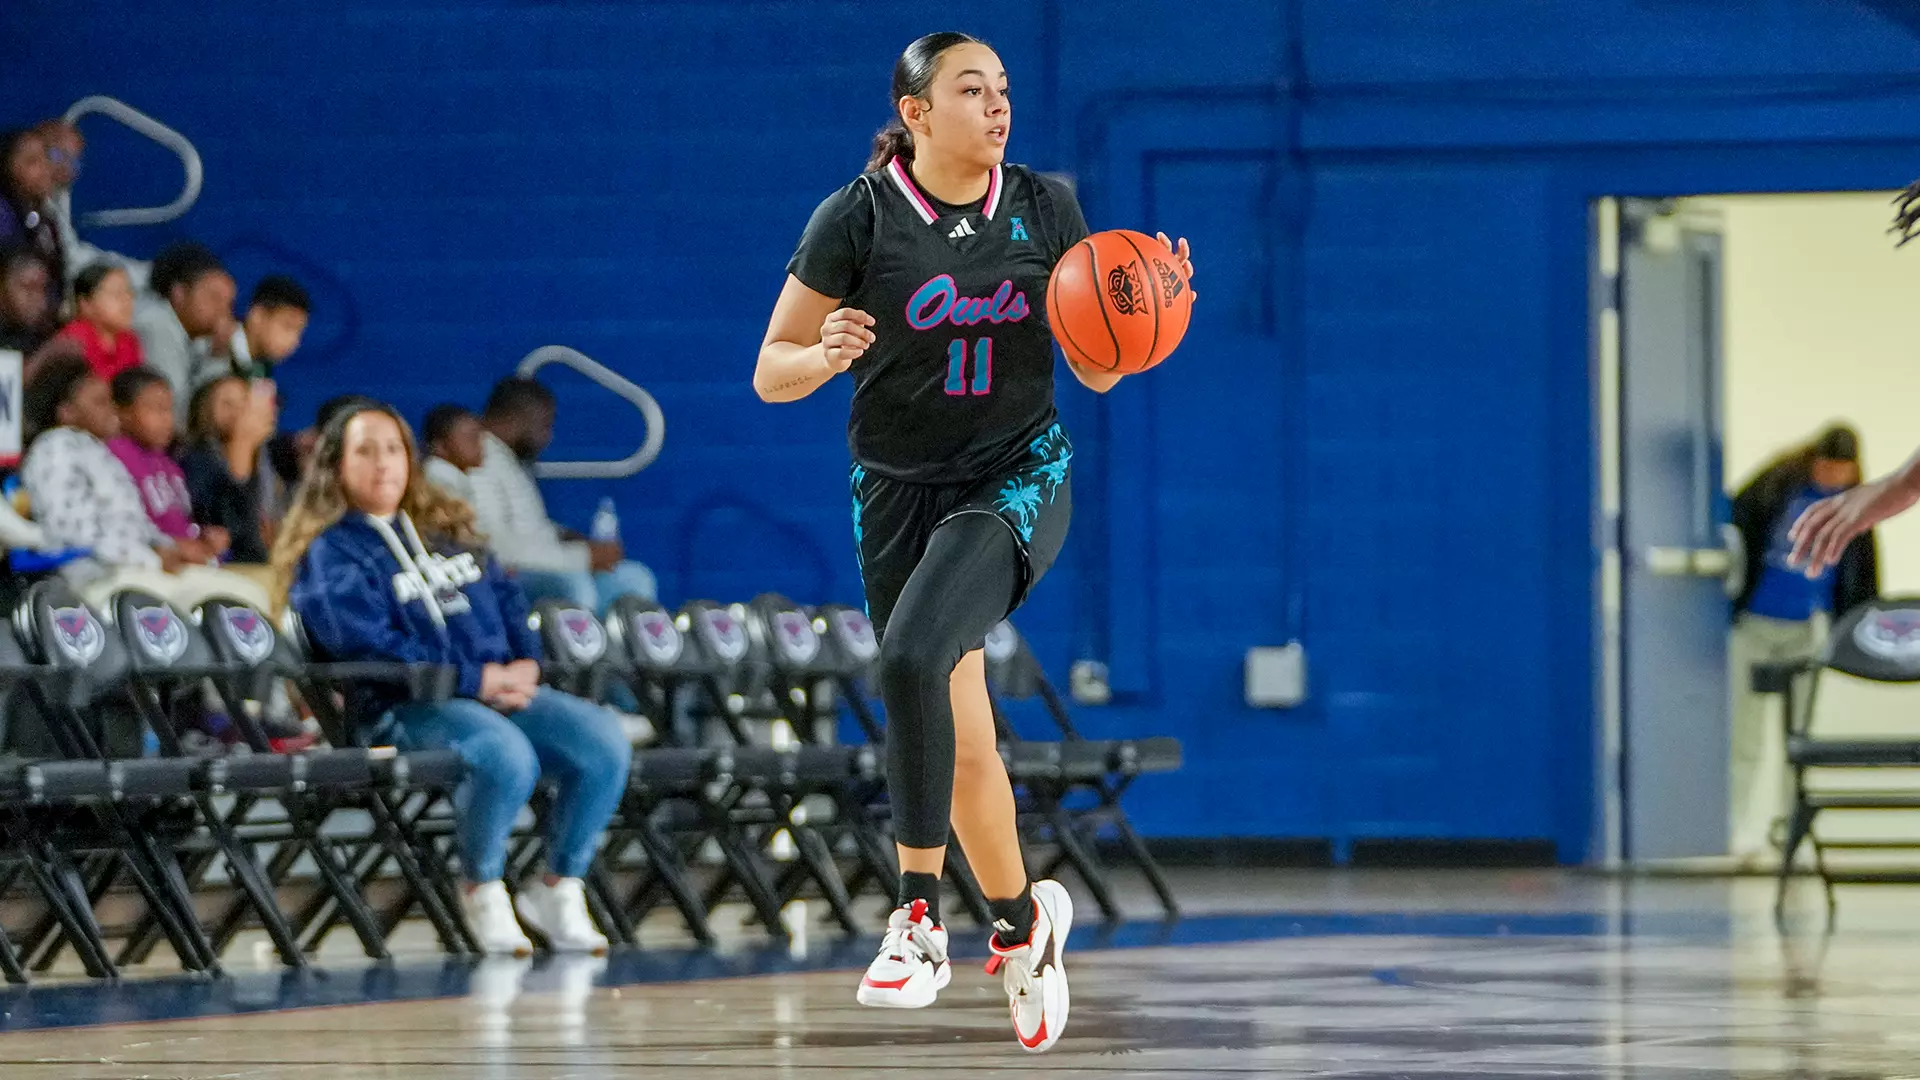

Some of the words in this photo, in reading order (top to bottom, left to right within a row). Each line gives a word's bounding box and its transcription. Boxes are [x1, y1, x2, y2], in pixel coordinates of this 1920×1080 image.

[905, 273, 1031, 331] Owls
[1153, 258, 1173, 308] adidas
[944, 337, 993, 396] 11
